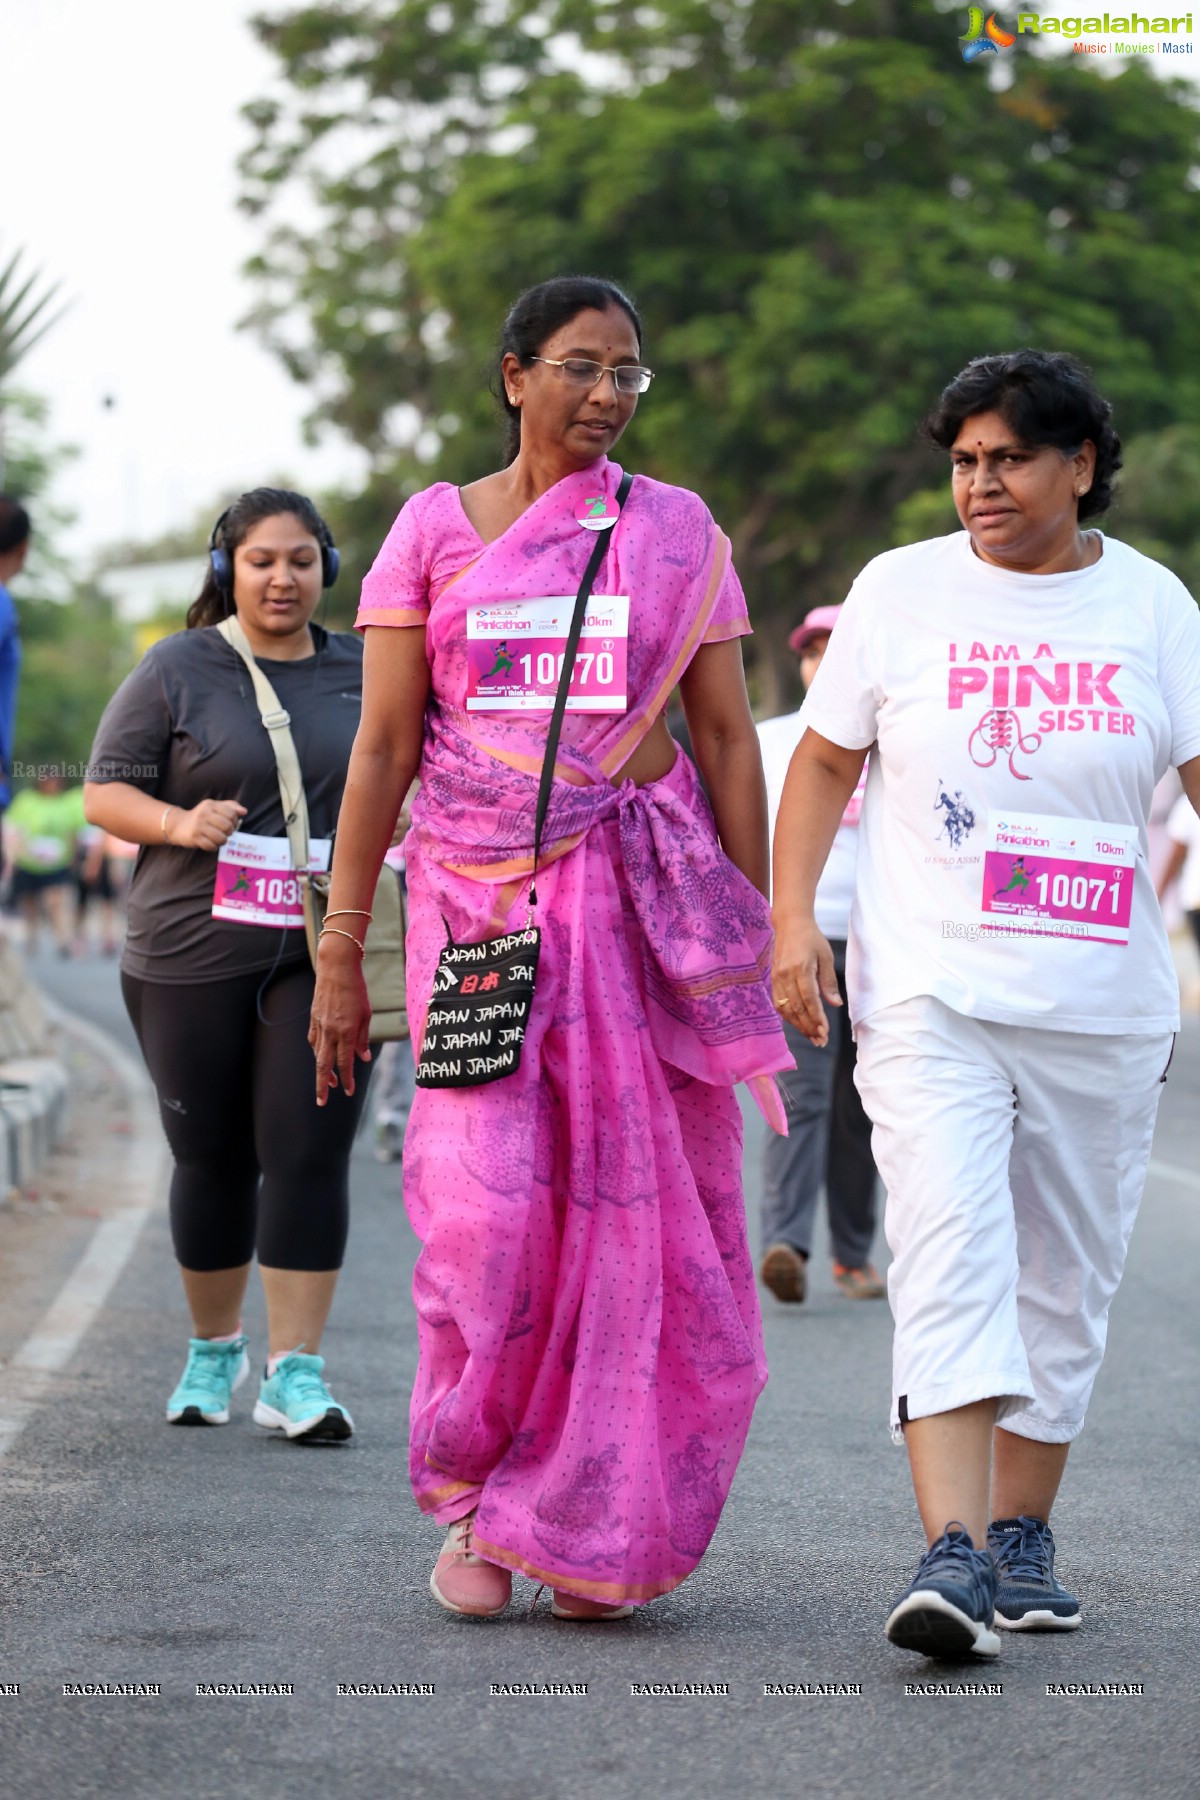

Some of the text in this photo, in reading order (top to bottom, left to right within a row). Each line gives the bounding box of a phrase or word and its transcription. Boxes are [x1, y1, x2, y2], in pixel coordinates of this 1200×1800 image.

[476, 620, 531, 630] Pinkathon
[948, 641, 1056, 662] I AM A
[948, 662, 1124, 709] PINK
[1038, 709, 1136, 736] SISTER
[996, 833, 1050, 847] Pinkathon
[1095, 842, 1124, 856] 10km
[1036, 873, 1121, 914] 10071
[460, 971, 500, 994] 日本
[427, 1002, 526, 1028] JAPAN JAPAN
[441, 1029, 491, 1051] JAPAN
[416, 1050, 514, 1079] JAPAN JAPAN
